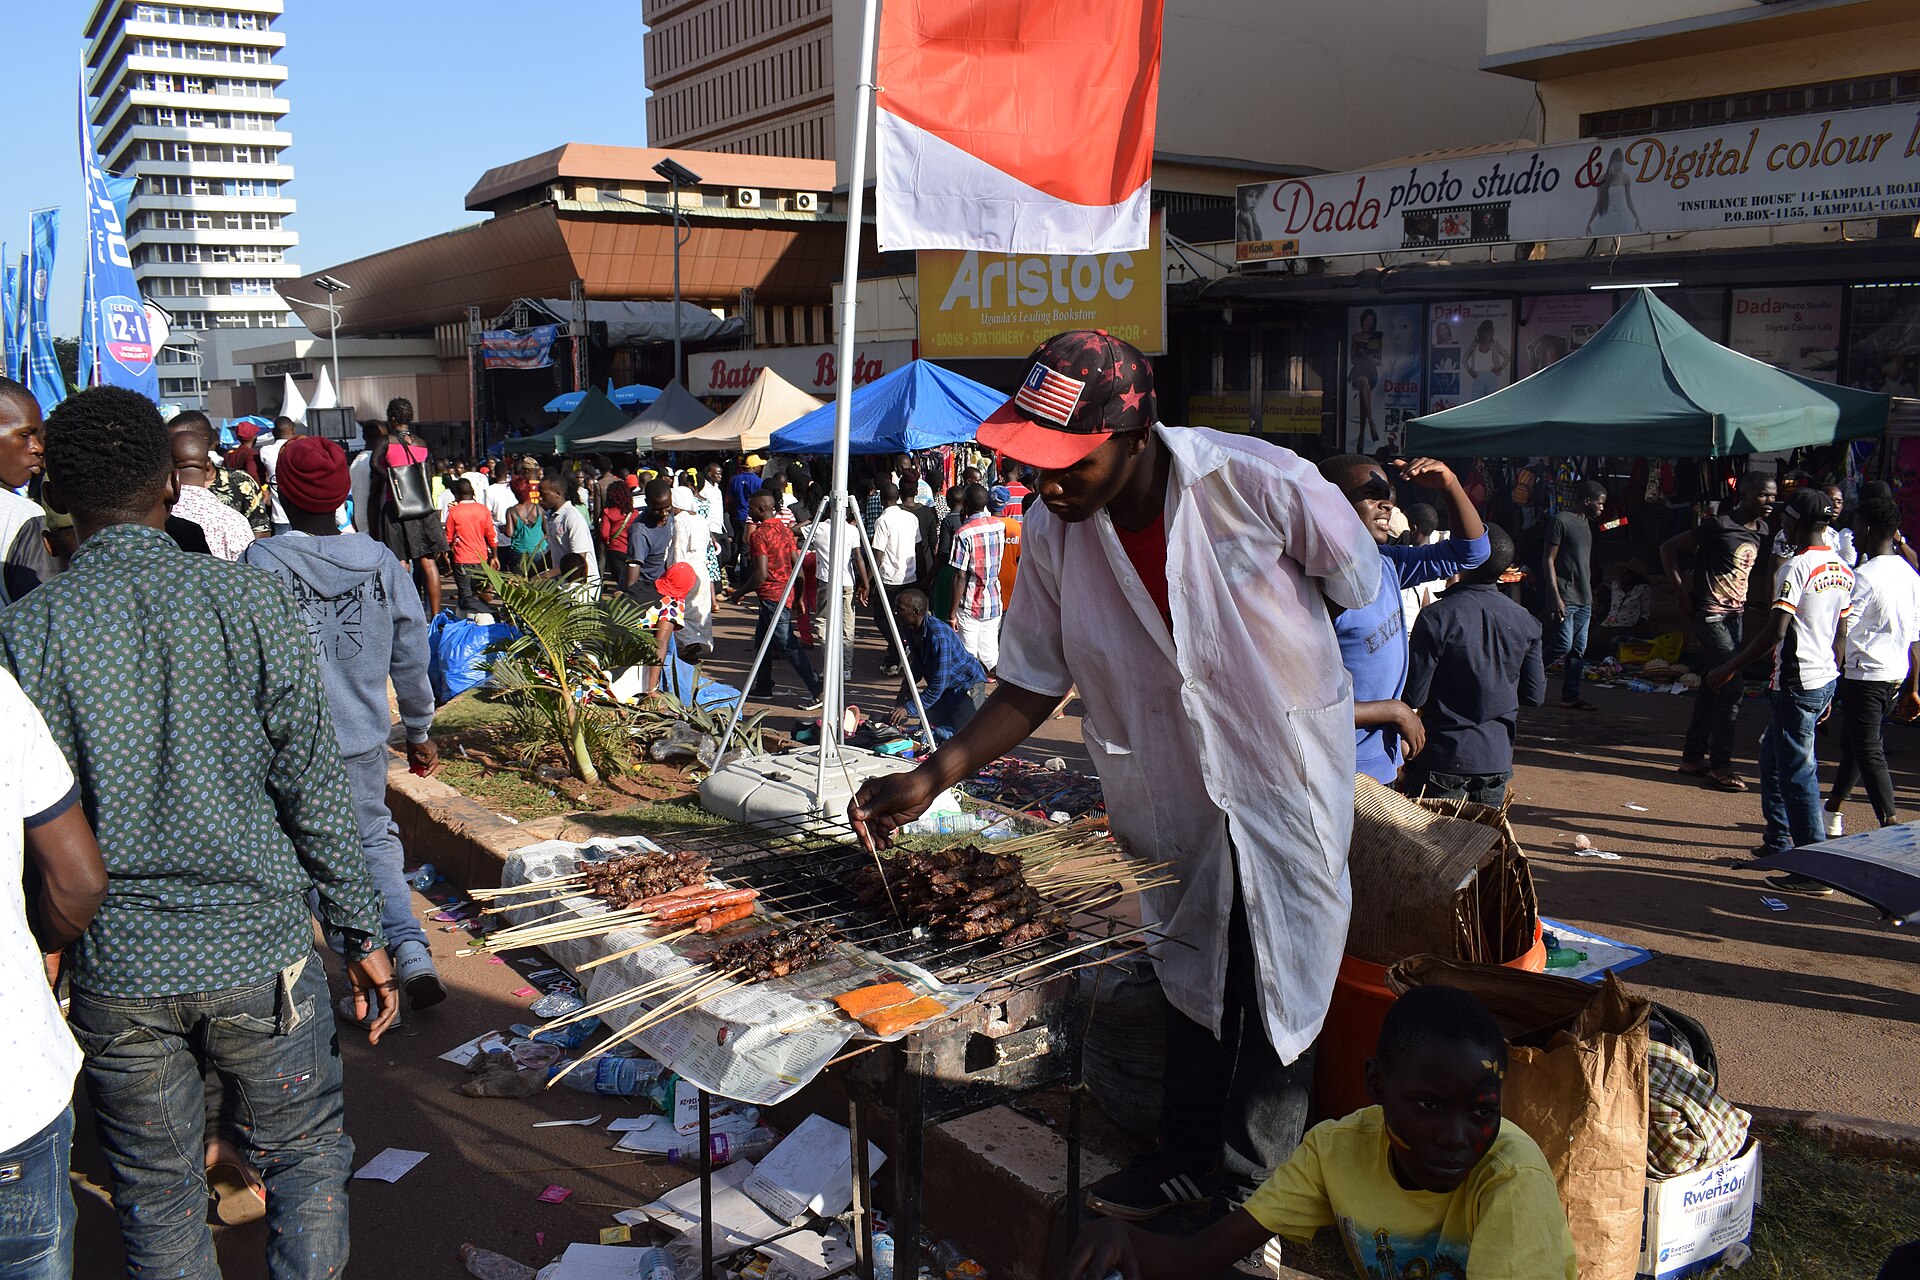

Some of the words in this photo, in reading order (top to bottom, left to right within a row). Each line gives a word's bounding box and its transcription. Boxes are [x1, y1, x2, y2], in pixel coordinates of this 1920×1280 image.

[1272, 176, 1381, 234] Dada
[1384, 167, 1463, 218] photo
[1472, 153, 1560, 199] studio
[1574, 145, 1604, 189] &
[1625, 128, 1760, 189] Digital
[1766, 119, 1893, 171] colour
[1678, 197, 1748, 212] "INSURANCE
[1751, 192, 1797, 206] HOUSE"
[1801, 185, 1882, 202] 14-KAMPALA
[1249, 242, 1274, 253] Kodak
[940, 251, 1135, 311] Aristoc
[108, 303, 134, 312] TECNO
[1434, 304, 1471, 320] Dada
[1737, 297, 1780, 314] Dada
[1782, 302, 1805, 310] Photo
[1807, 301, 1832, 309] Studio
[981, 312, 1016, 328] Uganda's
[1019, 310, 1051, 325] Leading
[1053, 308, 1097, 321] Bookstore
[1794, 311, 1802, 322] &
[107, 313, 147, 342] 12+1
[1765, 324, 1790, 334] Digital
[1791, 324, 1816, 332] Colour
[1818, 323, 1833, 331] Lab
[936, 332, 964, 346] BOOKS
[973, 330, 1025, 345] STATIONERY
[813, 352, 885, 387] Bta
[1384, 379, 1418, 393] Dada
[1263, 405, 1293, 416] Aristoc
[401, 957, 422, 969] SPORT
[1683, 1171, 1747, 1207] Rwenzori
